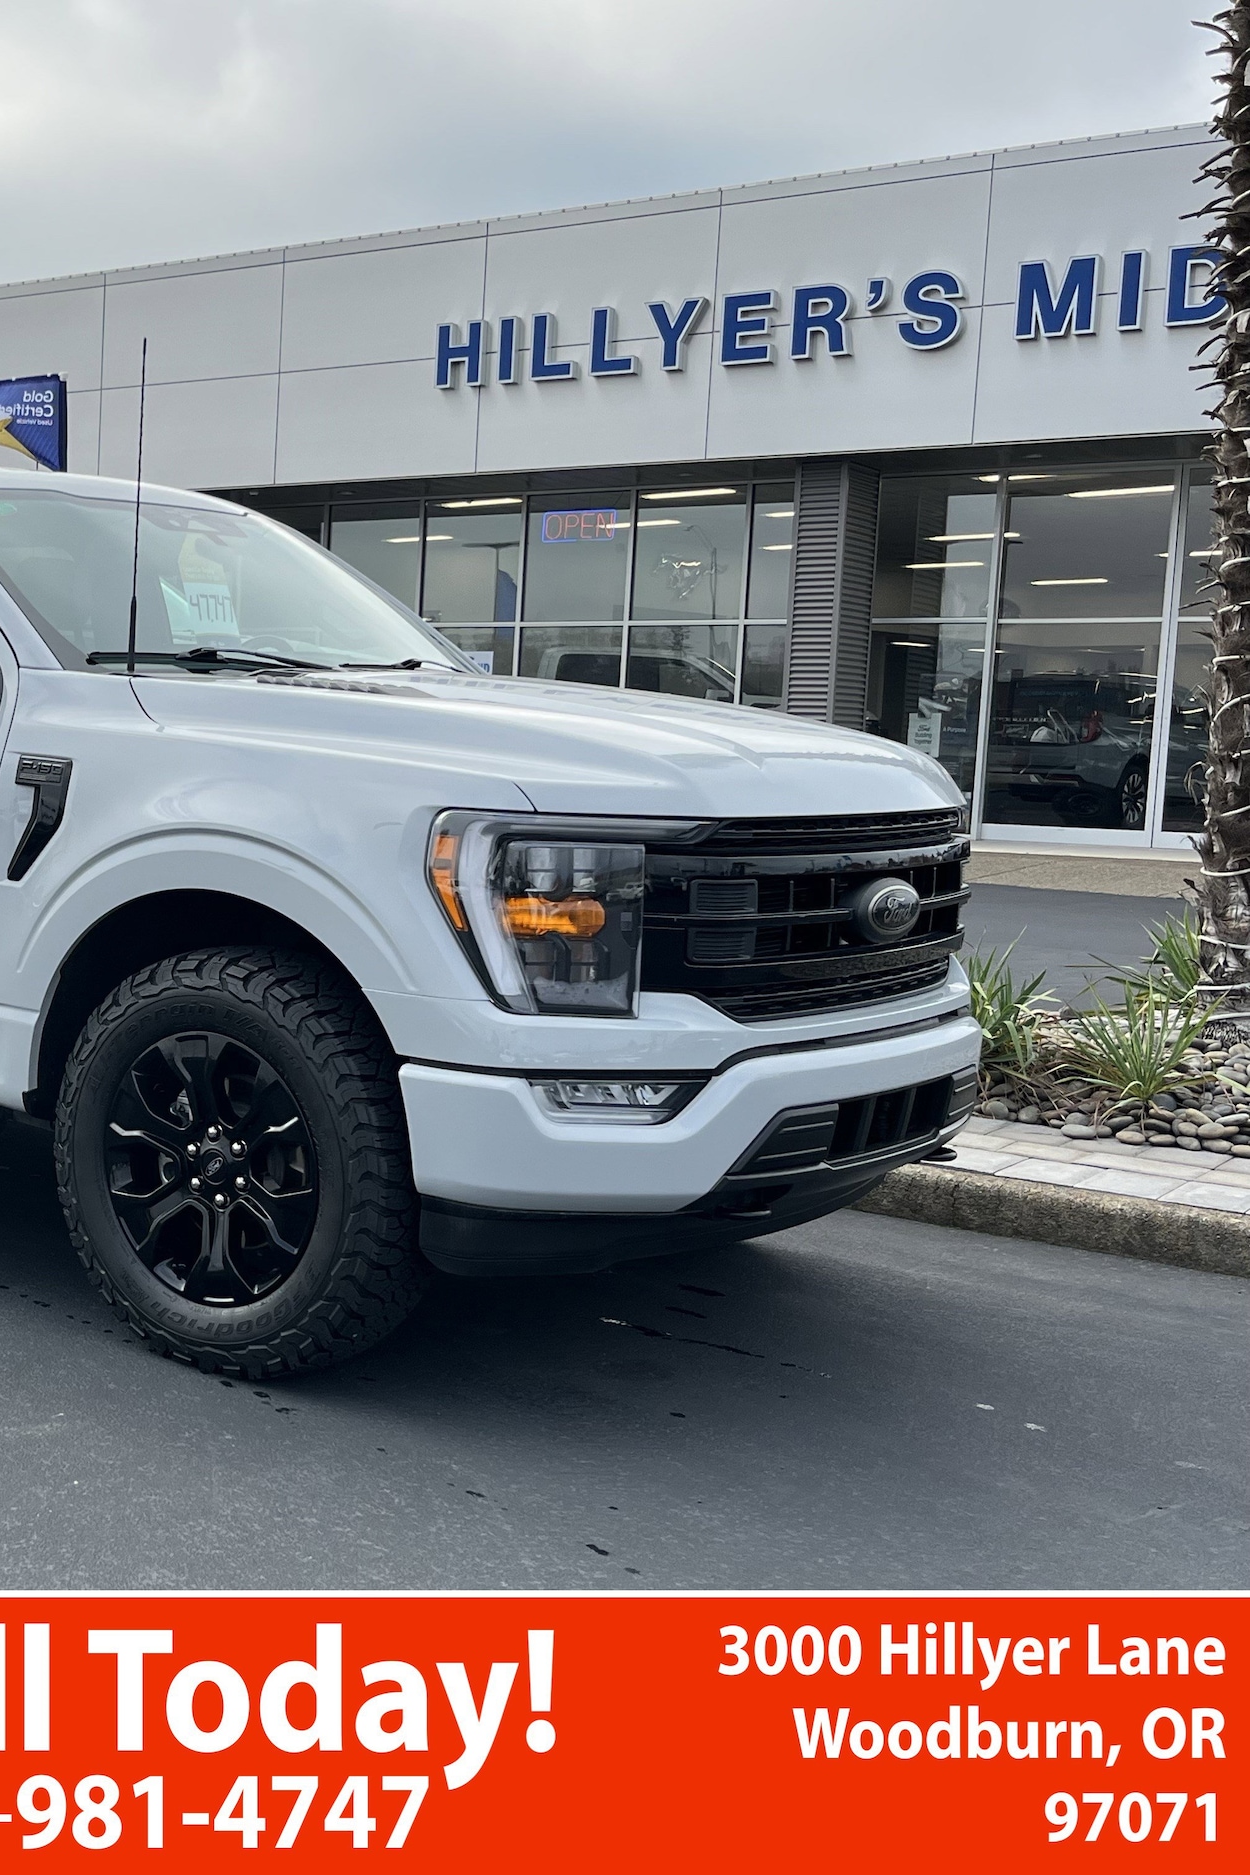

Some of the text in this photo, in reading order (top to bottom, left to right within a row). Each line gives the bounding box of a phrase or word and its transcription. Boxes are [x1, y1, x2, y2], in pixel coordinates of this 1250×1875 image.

[434, 243, 1234, 390] HILLYER'S MID
[545, 512, 614, 540] OPEN
[884, 896, 913, 923] Ford
